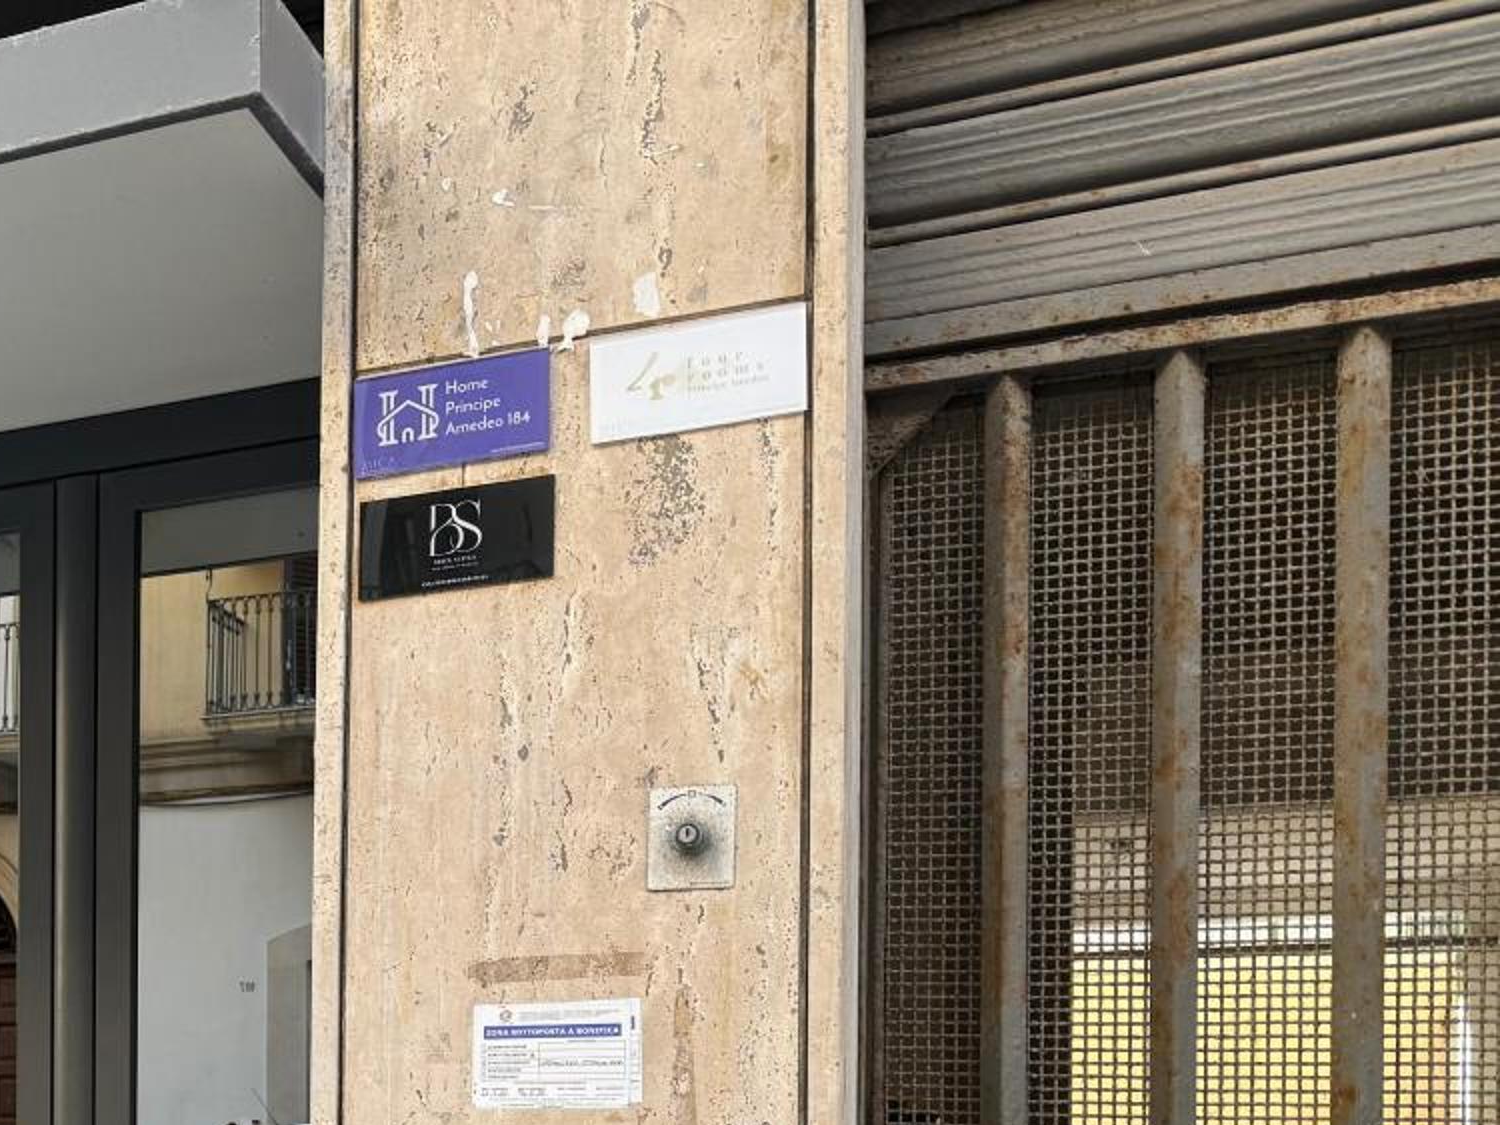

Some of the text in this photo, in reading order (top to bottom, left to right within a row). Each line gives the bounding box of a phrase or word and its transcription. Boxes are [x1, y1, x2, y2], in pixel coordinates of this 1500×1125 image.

[445, 379, 489, 395] Home
[445, 398, 501, 416] Principe
[445, 411, 531, 436] Amedeo 184
